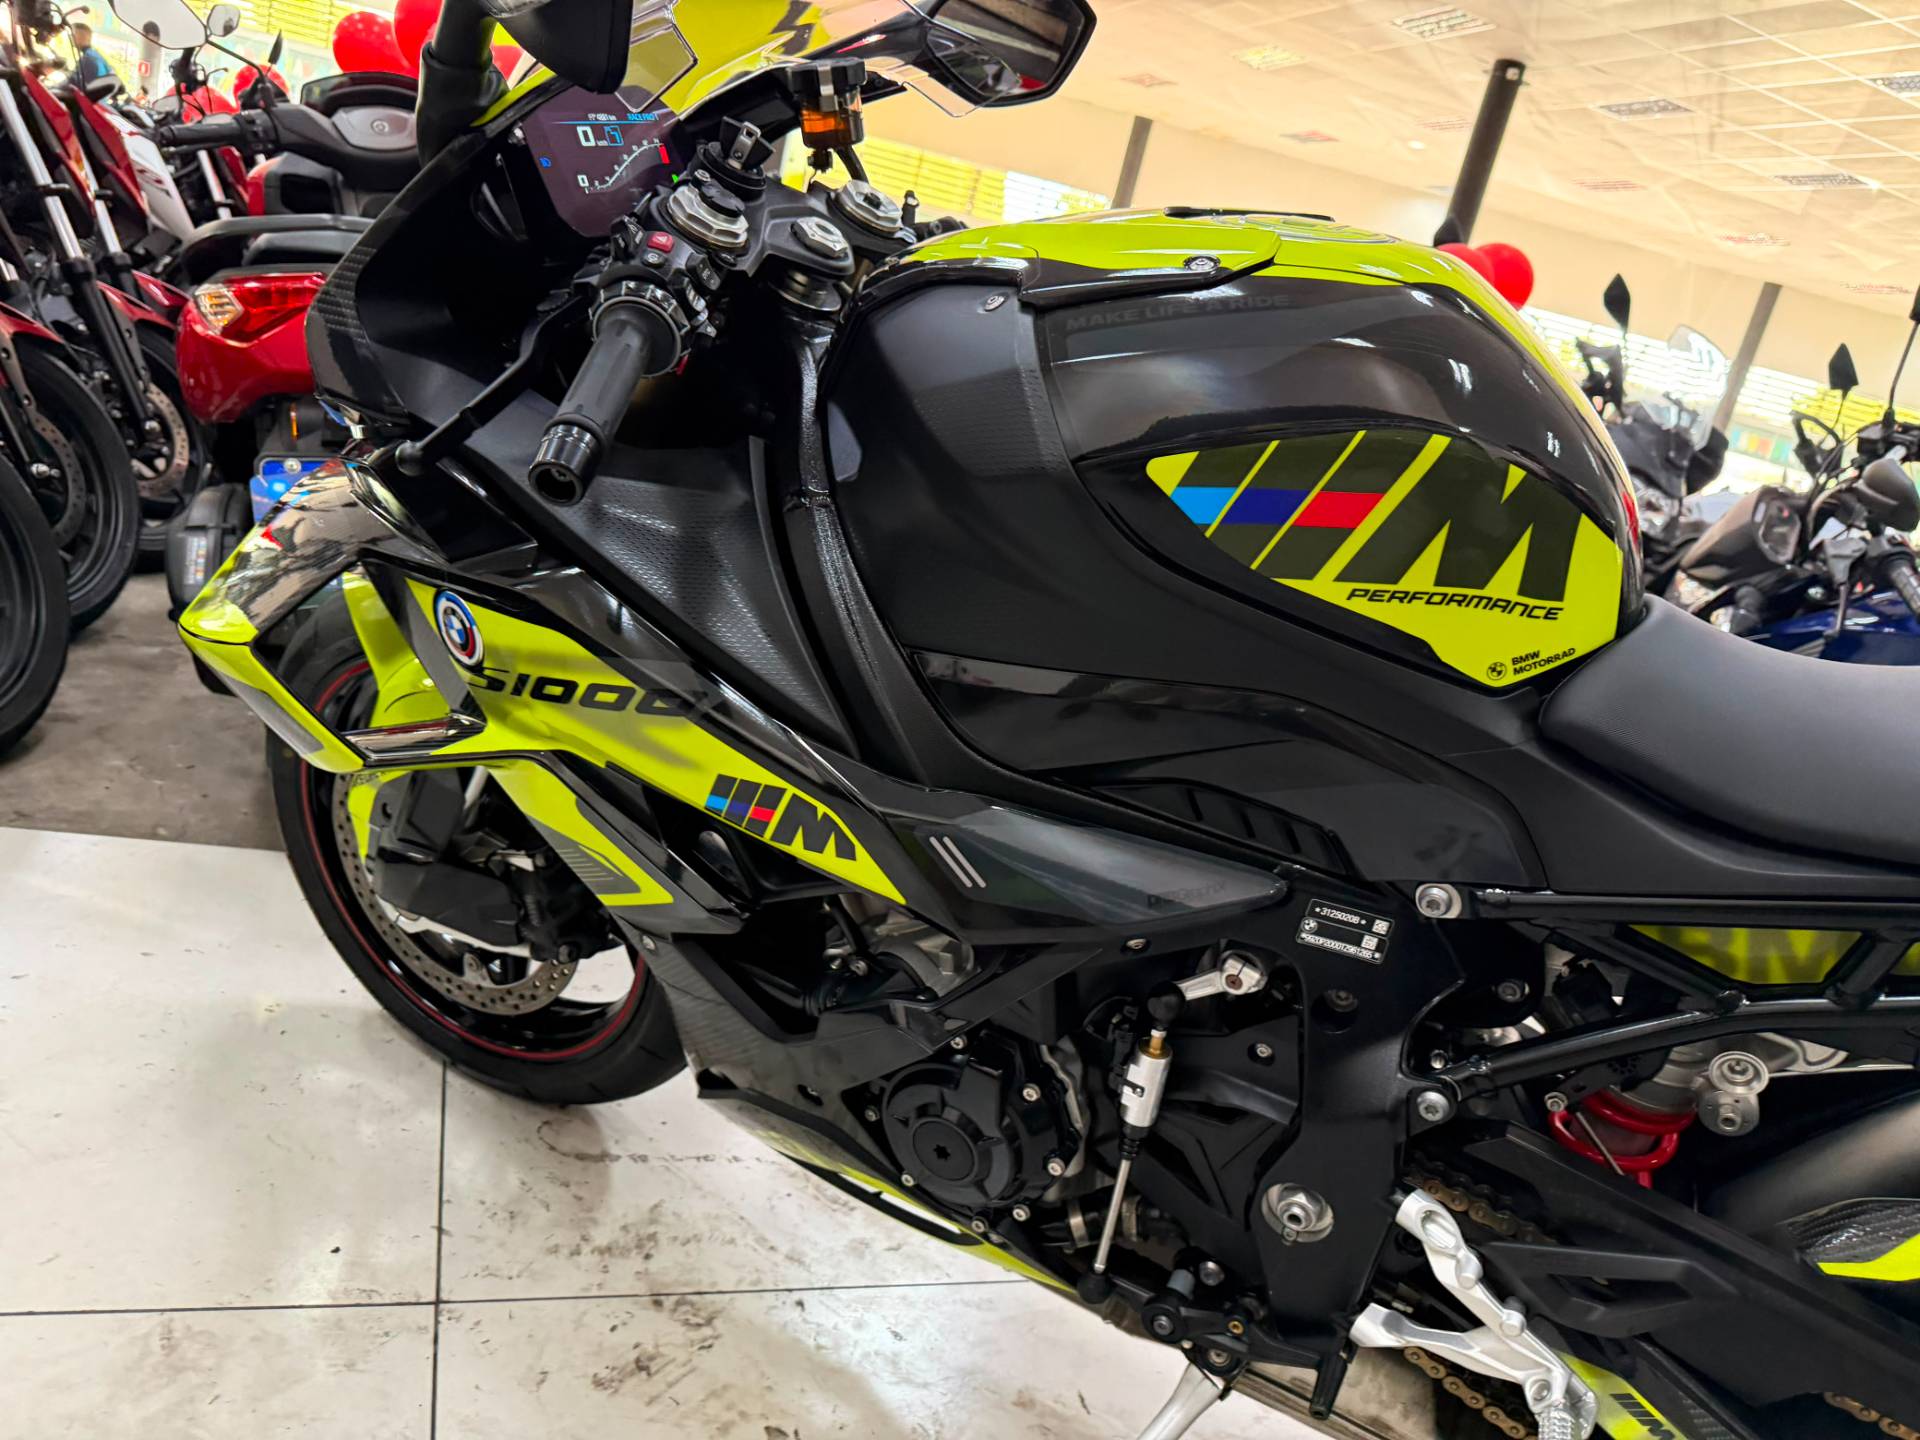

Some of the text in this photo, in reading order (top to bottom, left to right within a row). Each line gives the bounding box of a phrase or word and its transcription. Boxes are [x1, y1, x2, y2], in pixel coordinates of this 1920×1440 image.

[577, 126, 596, 146] 0
[1065, 295, 1290, 331] MAKE LIFE A RIDE
[1346, 587, 1565, 622] PERFORMANCE
[1511, 650, 1541, 667] BMW
[1512, 647, 1577, 676] MOTORRAD
